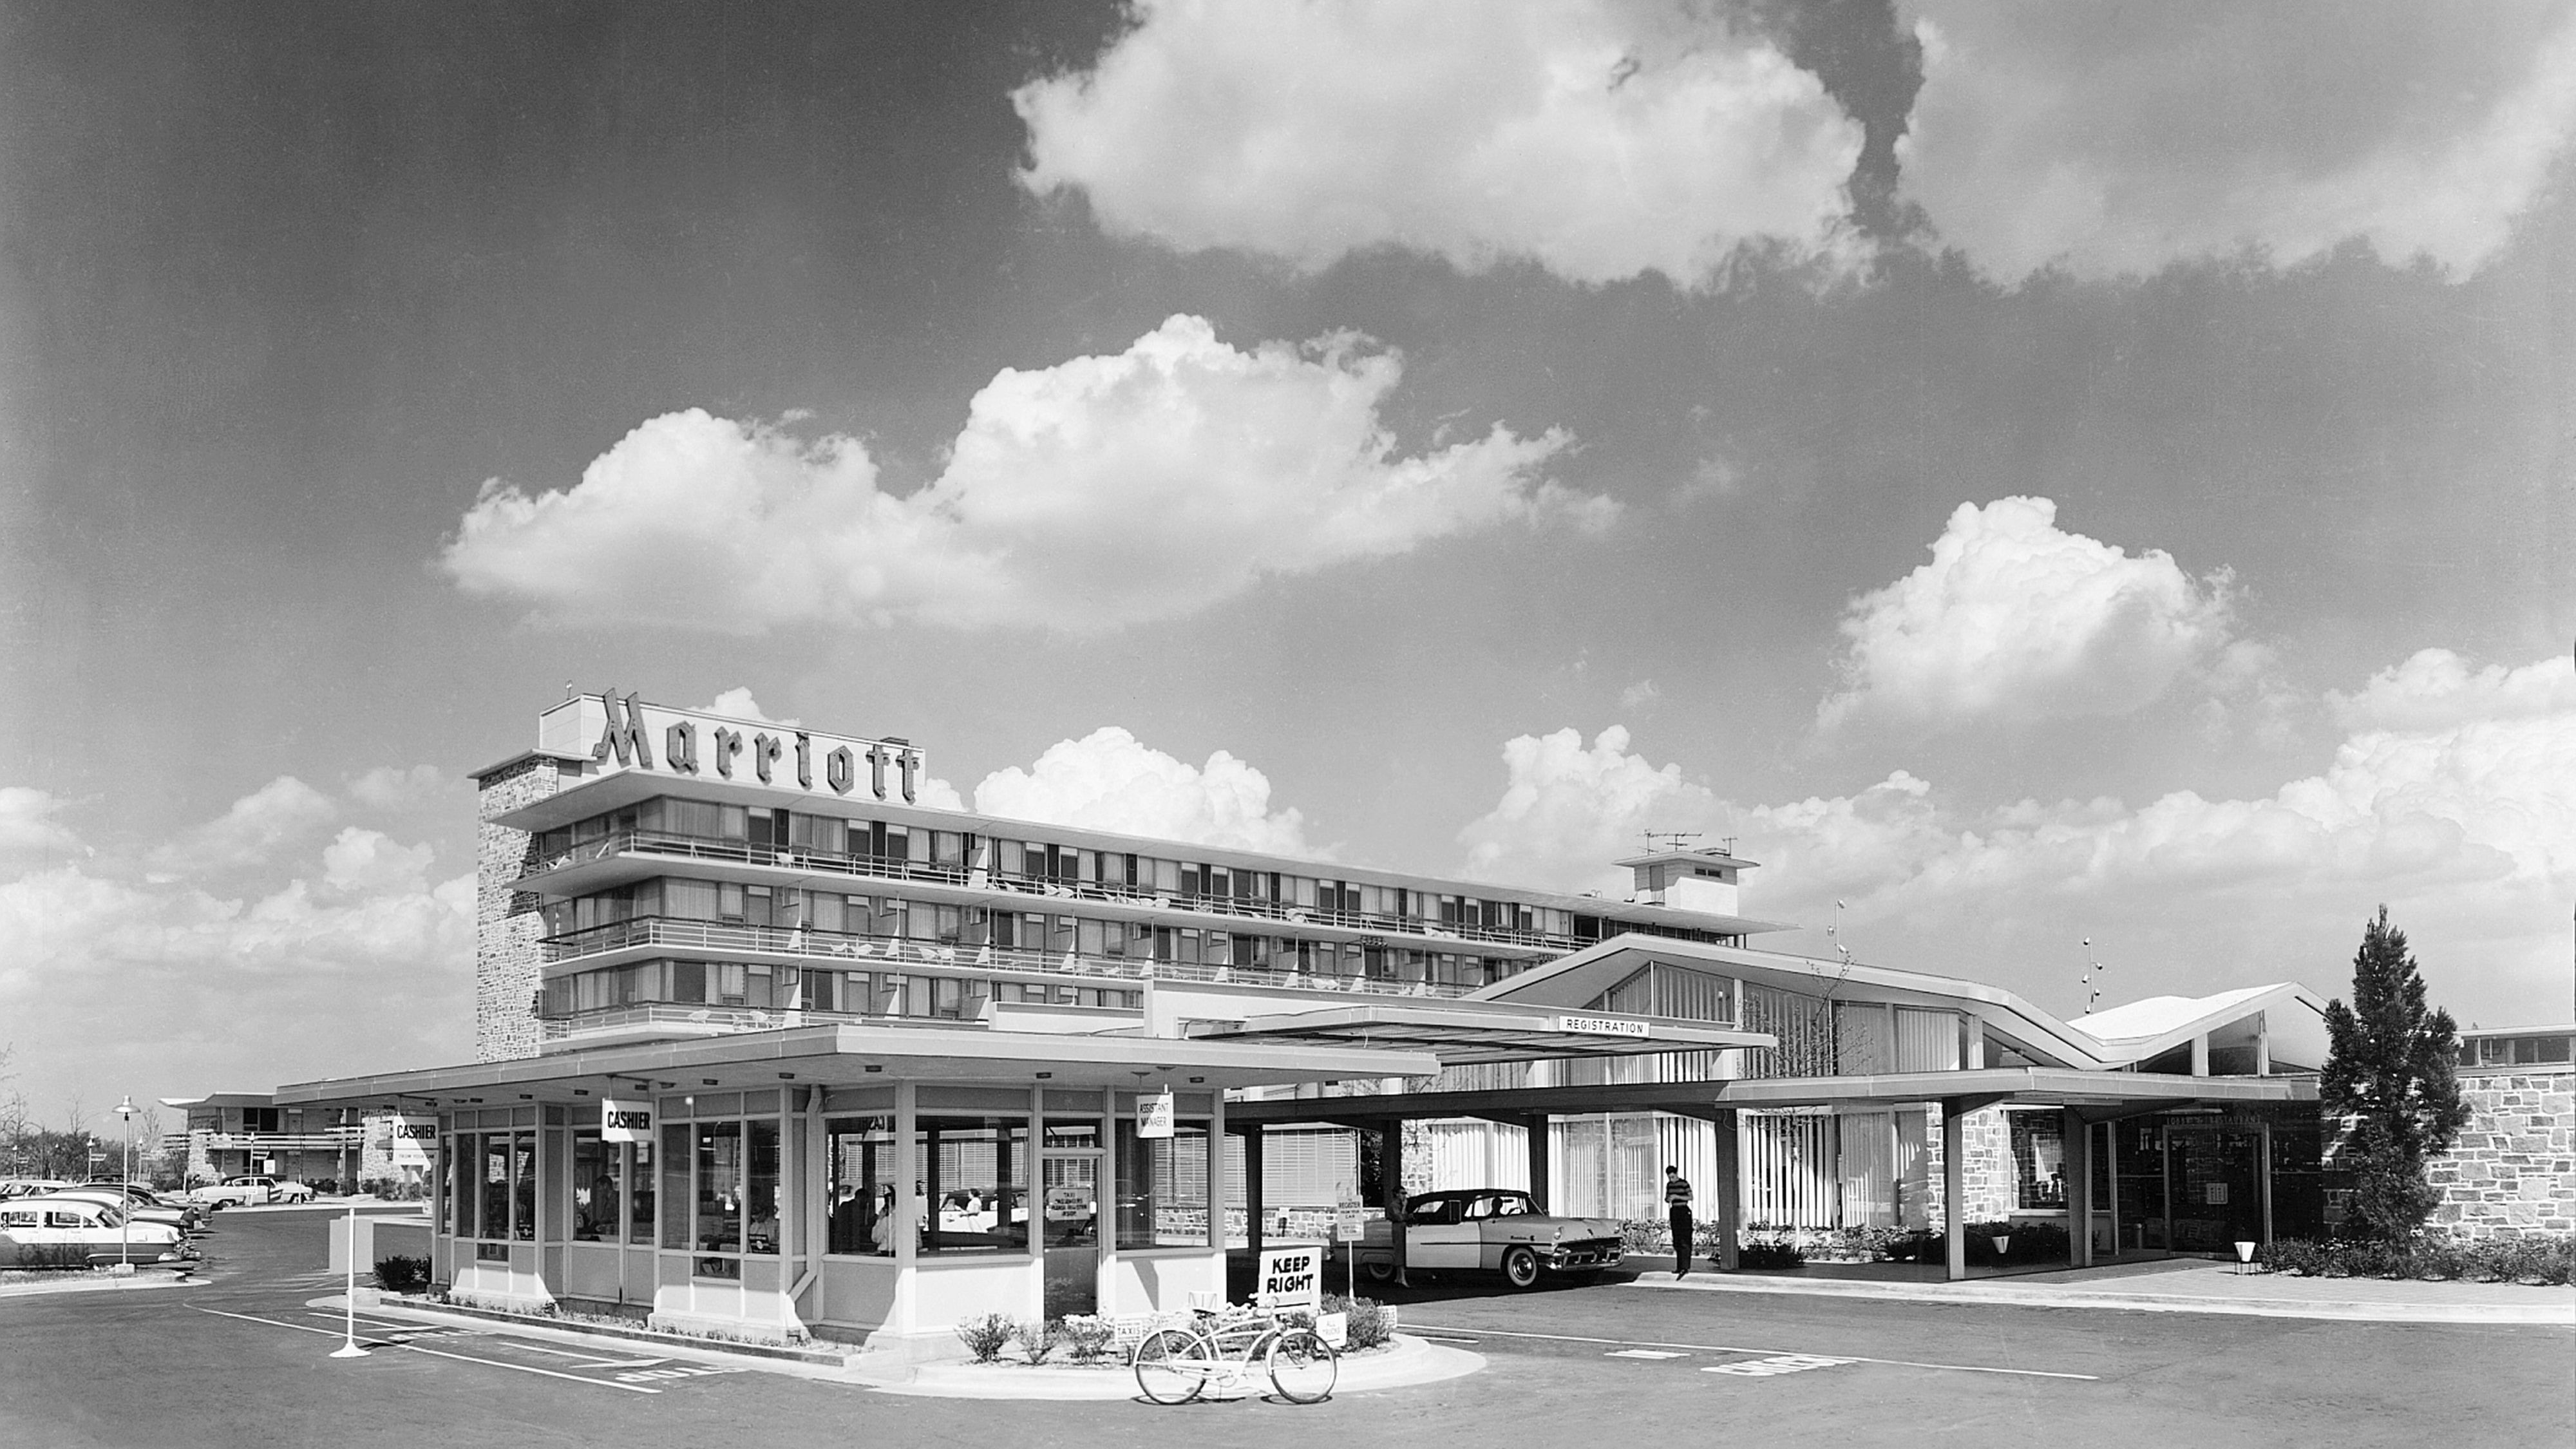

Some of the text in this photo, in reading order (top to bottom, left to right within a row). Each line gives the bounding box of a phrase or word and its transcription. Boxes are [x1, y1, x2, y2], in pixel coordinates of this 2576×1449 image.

[591, 687, 920, 806] Marriott
[1567, 1019, 1643, 1033] REGISTRATION
[1139, 1103, 1169, 1113] ASSISTANT
[608, 1111, 650, 1130] CASHIER
[1141, 1116, 1167, 1127] MANAGER
[397, 1124, 436, 1139] CASHIER
[1273, 1256, 1310, 1274] KEEP
[1267, 1273, 1314, 1294] RIGHT
[1117, 1327, 1140, 1335] TAXIS
